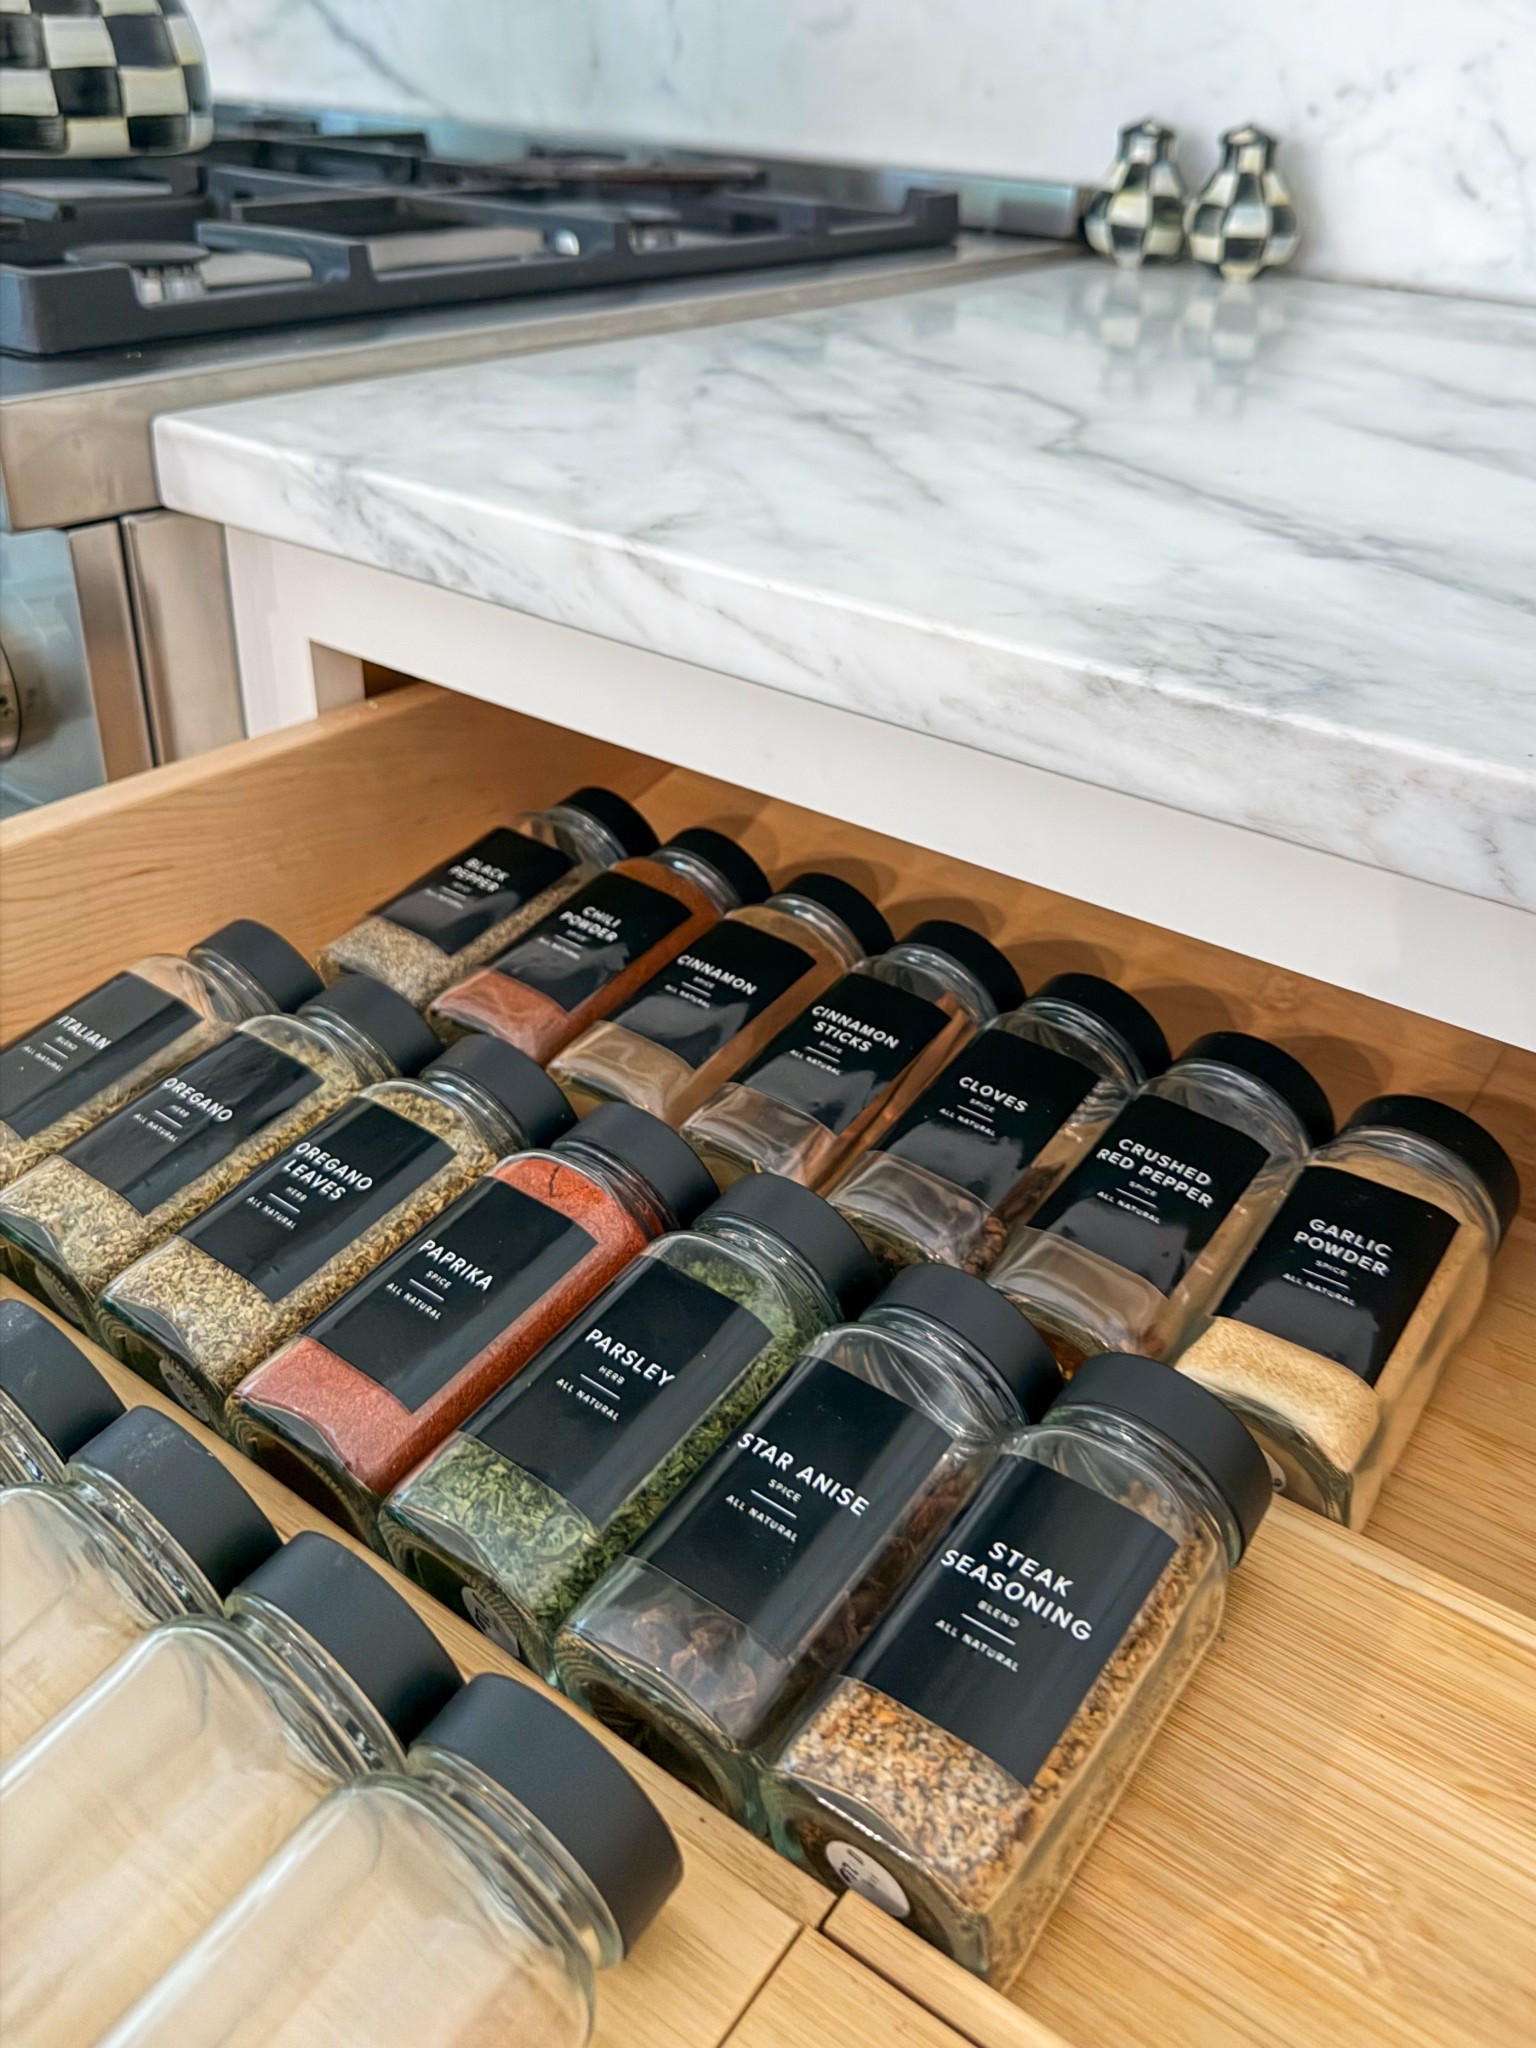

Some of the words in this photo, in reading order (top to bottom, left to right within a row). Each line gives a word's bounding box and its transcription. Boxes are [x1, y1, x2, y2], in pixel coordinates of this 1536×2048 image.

[464, 857, 510, 882] BLACK
[559, 911, 618, 942] POWDER
[582, 906, 622, 929] CHILI
[677, 954, 758, 996] CINNAMON
[56, 1015, 112, 1051] ITALIAN
[811, 1005, 900, 1049] CINNAMON
[813, 1021, 873, 1053] STICKS
[162, 1077, 233, 1123] OREGANO
[959, 1076, 1029, 1112] CLOVES
[969, 1098, 996, 1113] SPICE
[938, 1107, 956, 1119] ALL
[957, 1115, 997, 1138] NATURAL
[282, 1159, 347, 1201] LEAVES
[294, 1141, 373, 1192] OREGANO
[1096, 1148, 1136, 1170] RED
[1138, 1165, 1215, 1209] PEPPER
[1118, 1138, 1213, 1186] CRUSHED
[284, 1186, 308, 1202] HERB
[1128, 1180, 1159, 1198] SPICE
[246, 1196, 263, 1209] ALL
[261, 1204, 297, 1230] NATURAL
[1096, 1191, 1116, 1204] ALL
[1116, 1199, 1161, 1226] NATURAL
[1293, 1231, 1390, 1278] POWDER
[1309, 1218, 1394, 1260] GARLIC
[418, 1239, 494, 1292] PAPRIKA
[424, 1269, 453, 1290] SPICE
[1314, 1259, 1350, 1278] SPICE
[385, 1282, 404, 1297] ALL
[402, 1292, 442, 1321] NATURAL
[1281, 1272, 1304, 1286] ALL
[1304, 1281, 1357, 1307] NATURAL
[584, 1328, 676, 1387] PARSLEY
[597, 1365, 626, 1385] HERB
[556, 1378, 574, 1394] ALL
[575, 1389, 620, 1421] NATURAL
[736, 1432, 795, 1472] STAR
[795, 1465, 871, 1518] ANISE
[767, 1478, 802, 1503] SPICE
[725, 1494, 746, 1512] ALL
[748, 1506, 798, 1544] NATURAL
[987, 1541, 1075, 1598] STEAK
[940, 1549, 1093, 1641] SEASONING
[977, 1599, 1021, 1629] BLEND
[934, 1619, 959, 1638] ALL
[961, 1633, 1020, 1673] NATURAL
